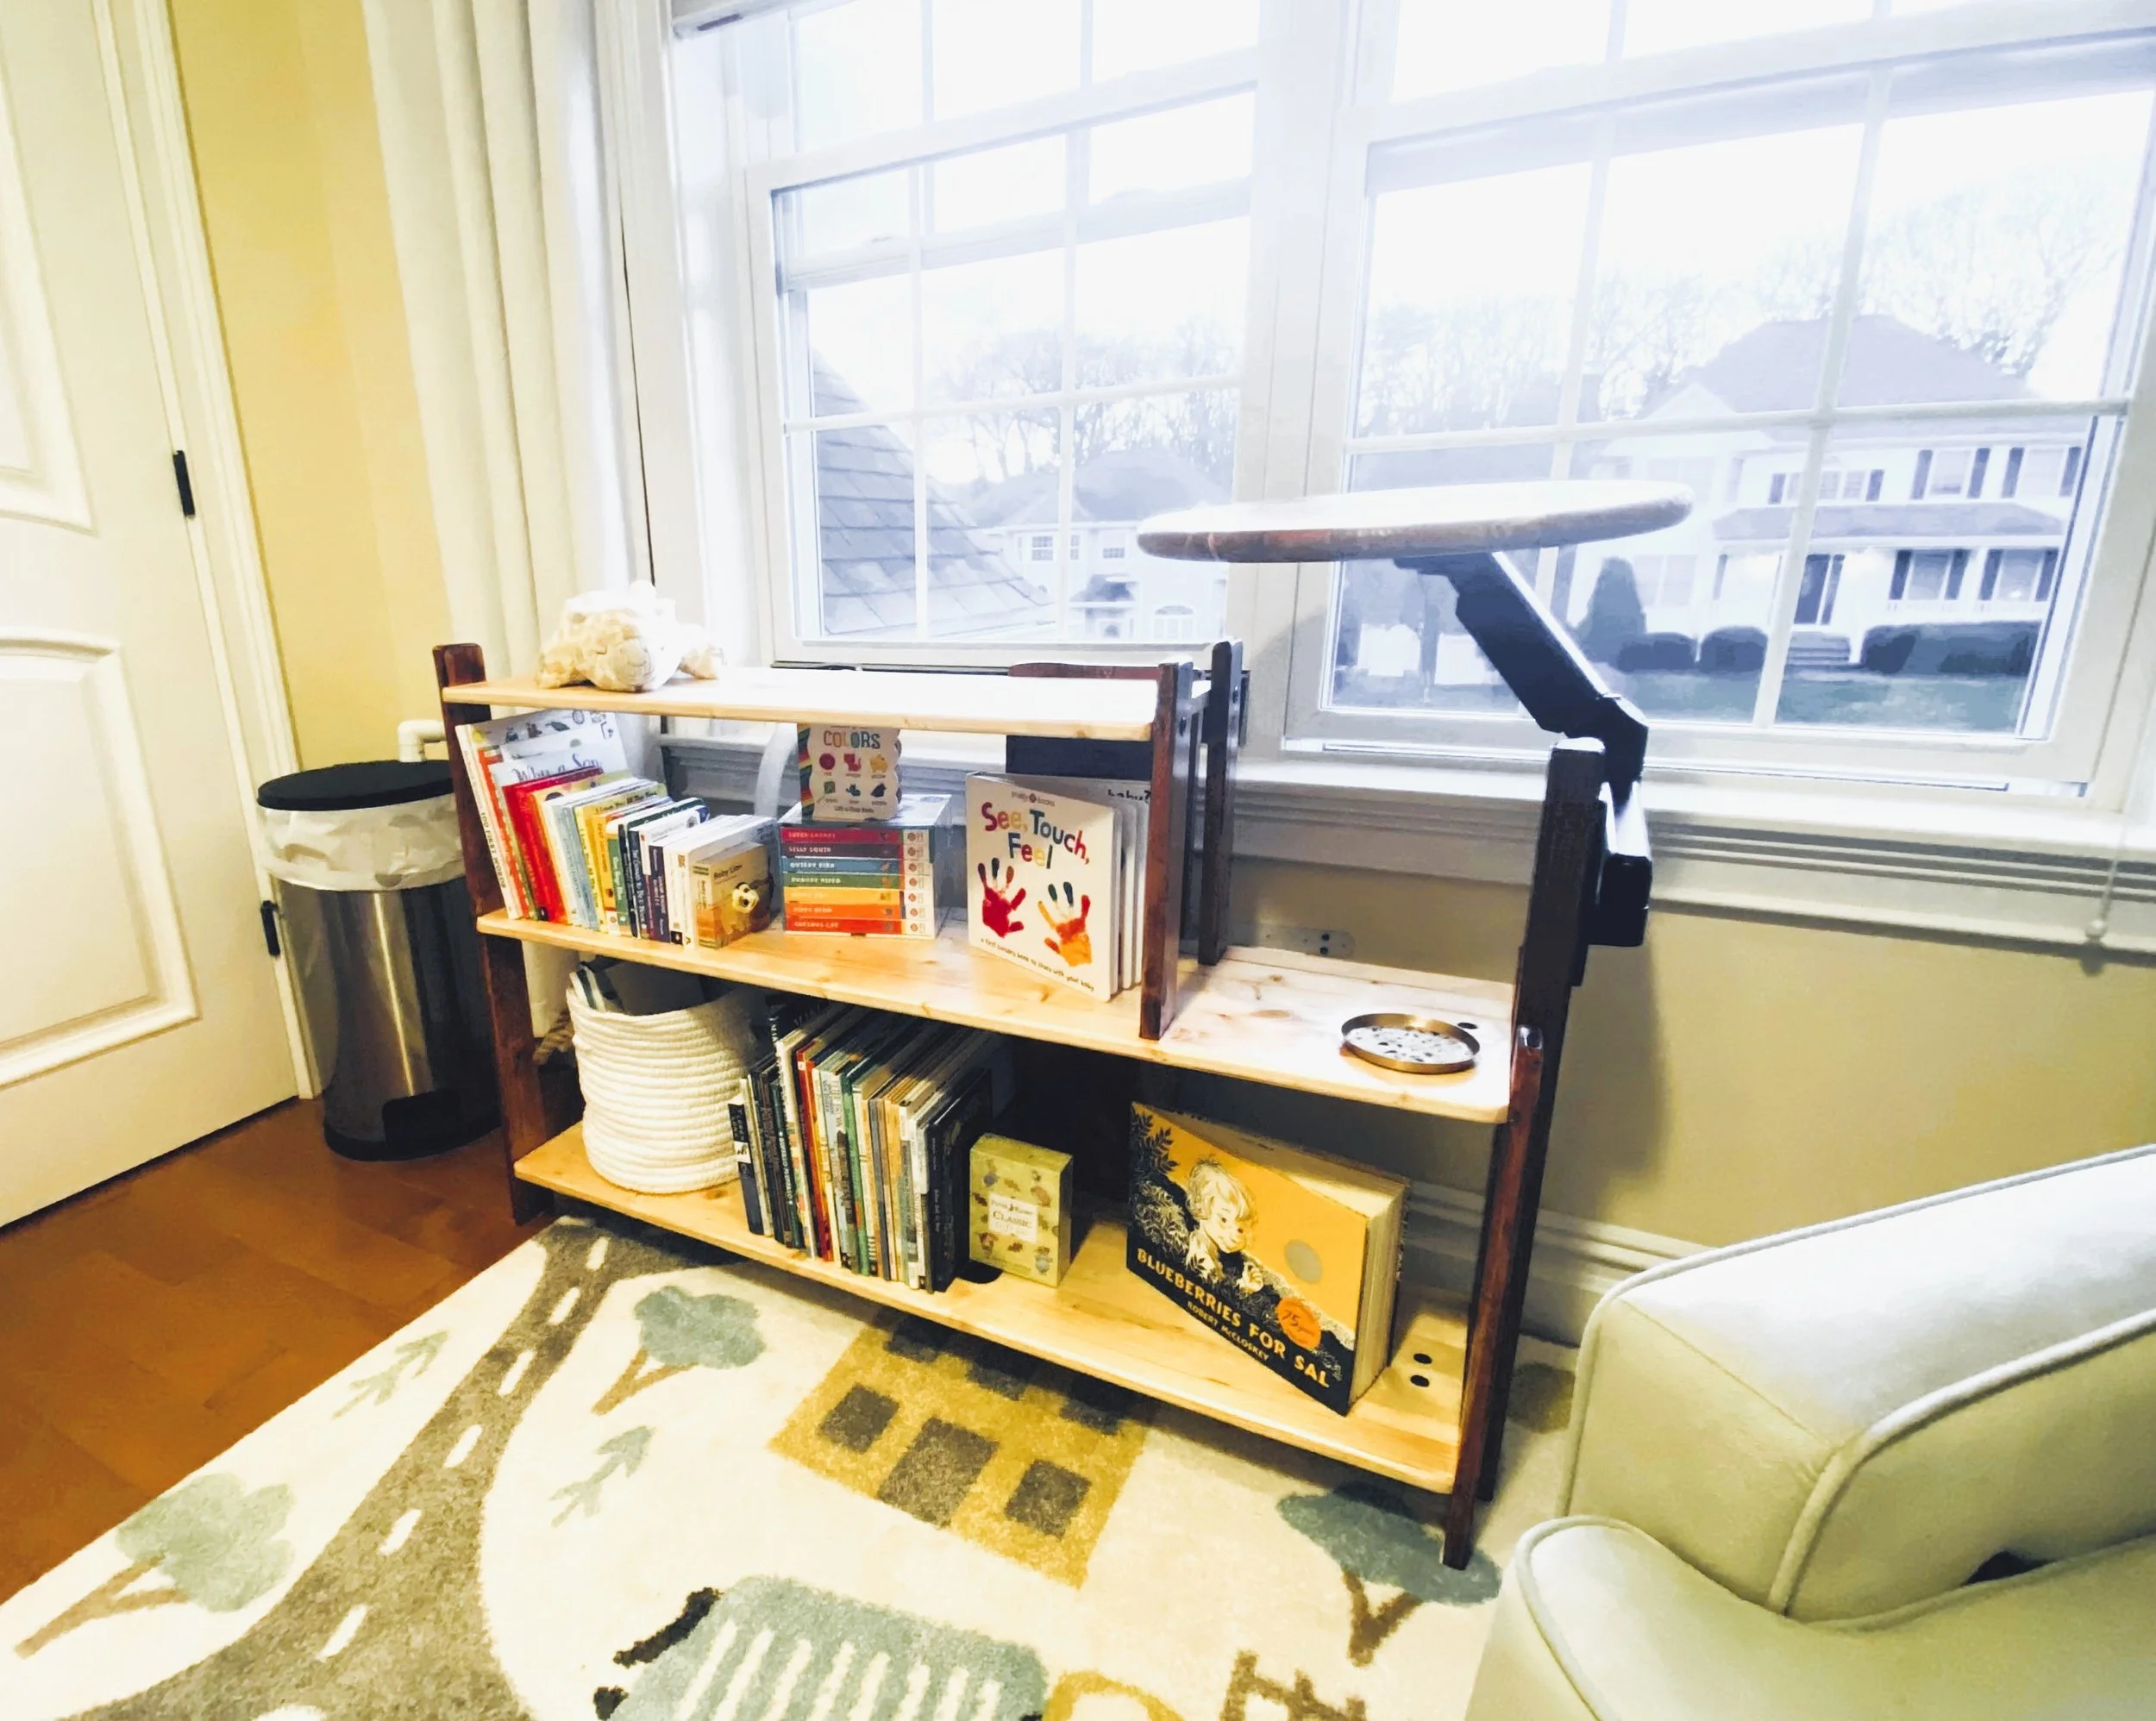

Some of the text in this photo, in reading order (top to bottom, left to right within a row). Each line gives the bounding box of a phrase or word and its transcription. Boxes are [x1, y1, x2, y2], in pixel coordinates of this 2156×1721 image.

[824, 730, 881, 749] COLORS
[479, 810, 506, 889] 100 FIRST WORDS
[981, 801, 1091, 866] See, Touch,
[1007, 832, 1054, 870] Feel
[993, 1211, 1032, 1229] CLASSIC
[1137, 1248, 1330, 1388] BLUEBERRIES FOR SAL
[1187, 1300, 1269, 1361] ROBERT McCLOSKEY
[1282, 1310, 1300, 1327] 75
